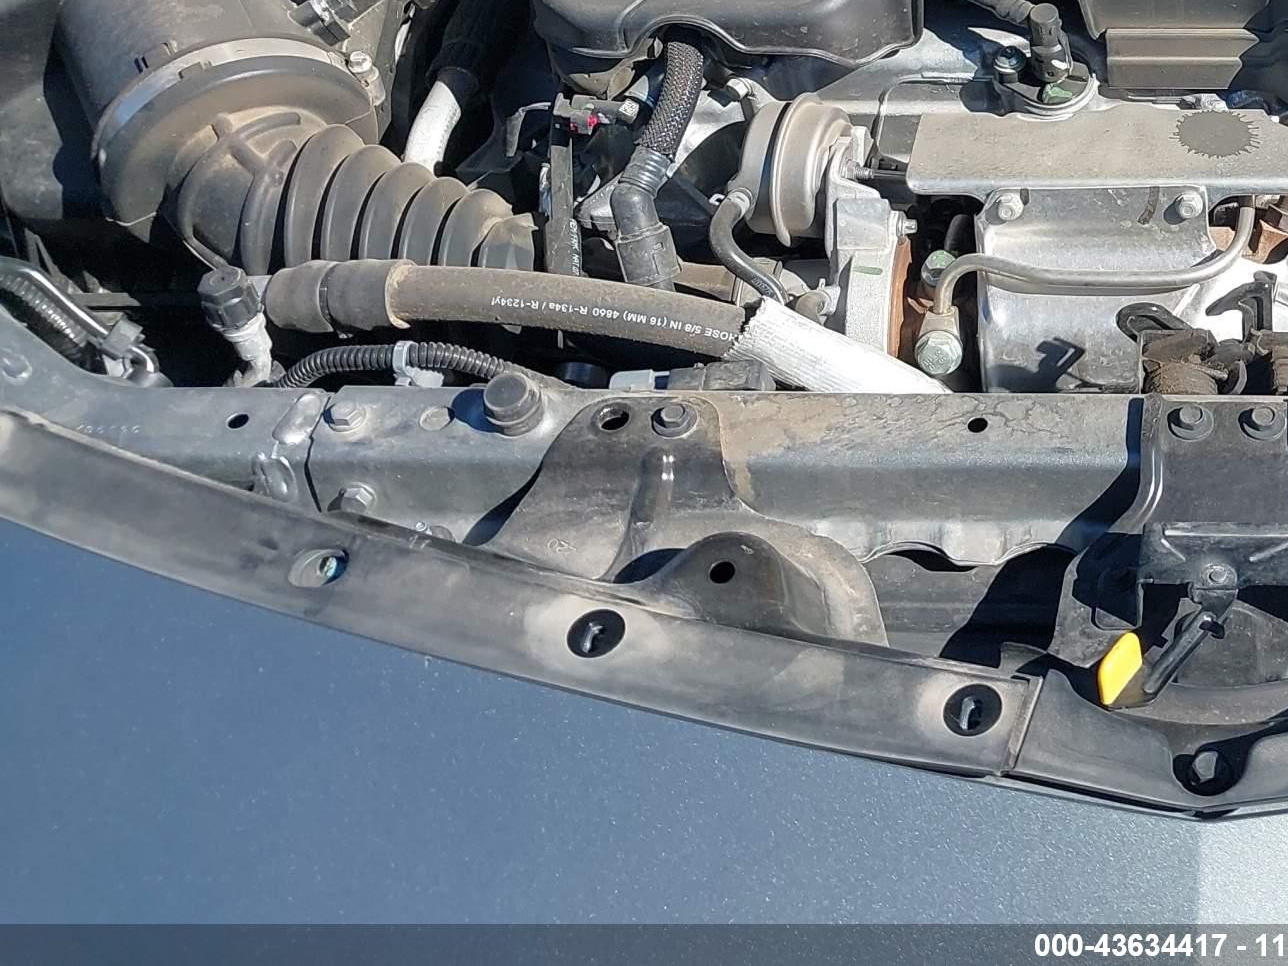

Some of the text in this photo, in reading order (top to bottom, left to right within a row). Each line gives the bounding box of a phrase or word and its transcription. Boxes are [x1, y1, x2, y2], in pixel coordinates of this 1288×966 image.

[490, 296, 540, 311] R-1234yf
[549, 300, 588, 316] R-134a
[592, 306, 620, 320] 4860
[623, 309, 648, 326] MM)
[649, 314, 669, 330] (16
[669, 319, 683, 332] IN
[684, 322, 702, 335] 5/8
